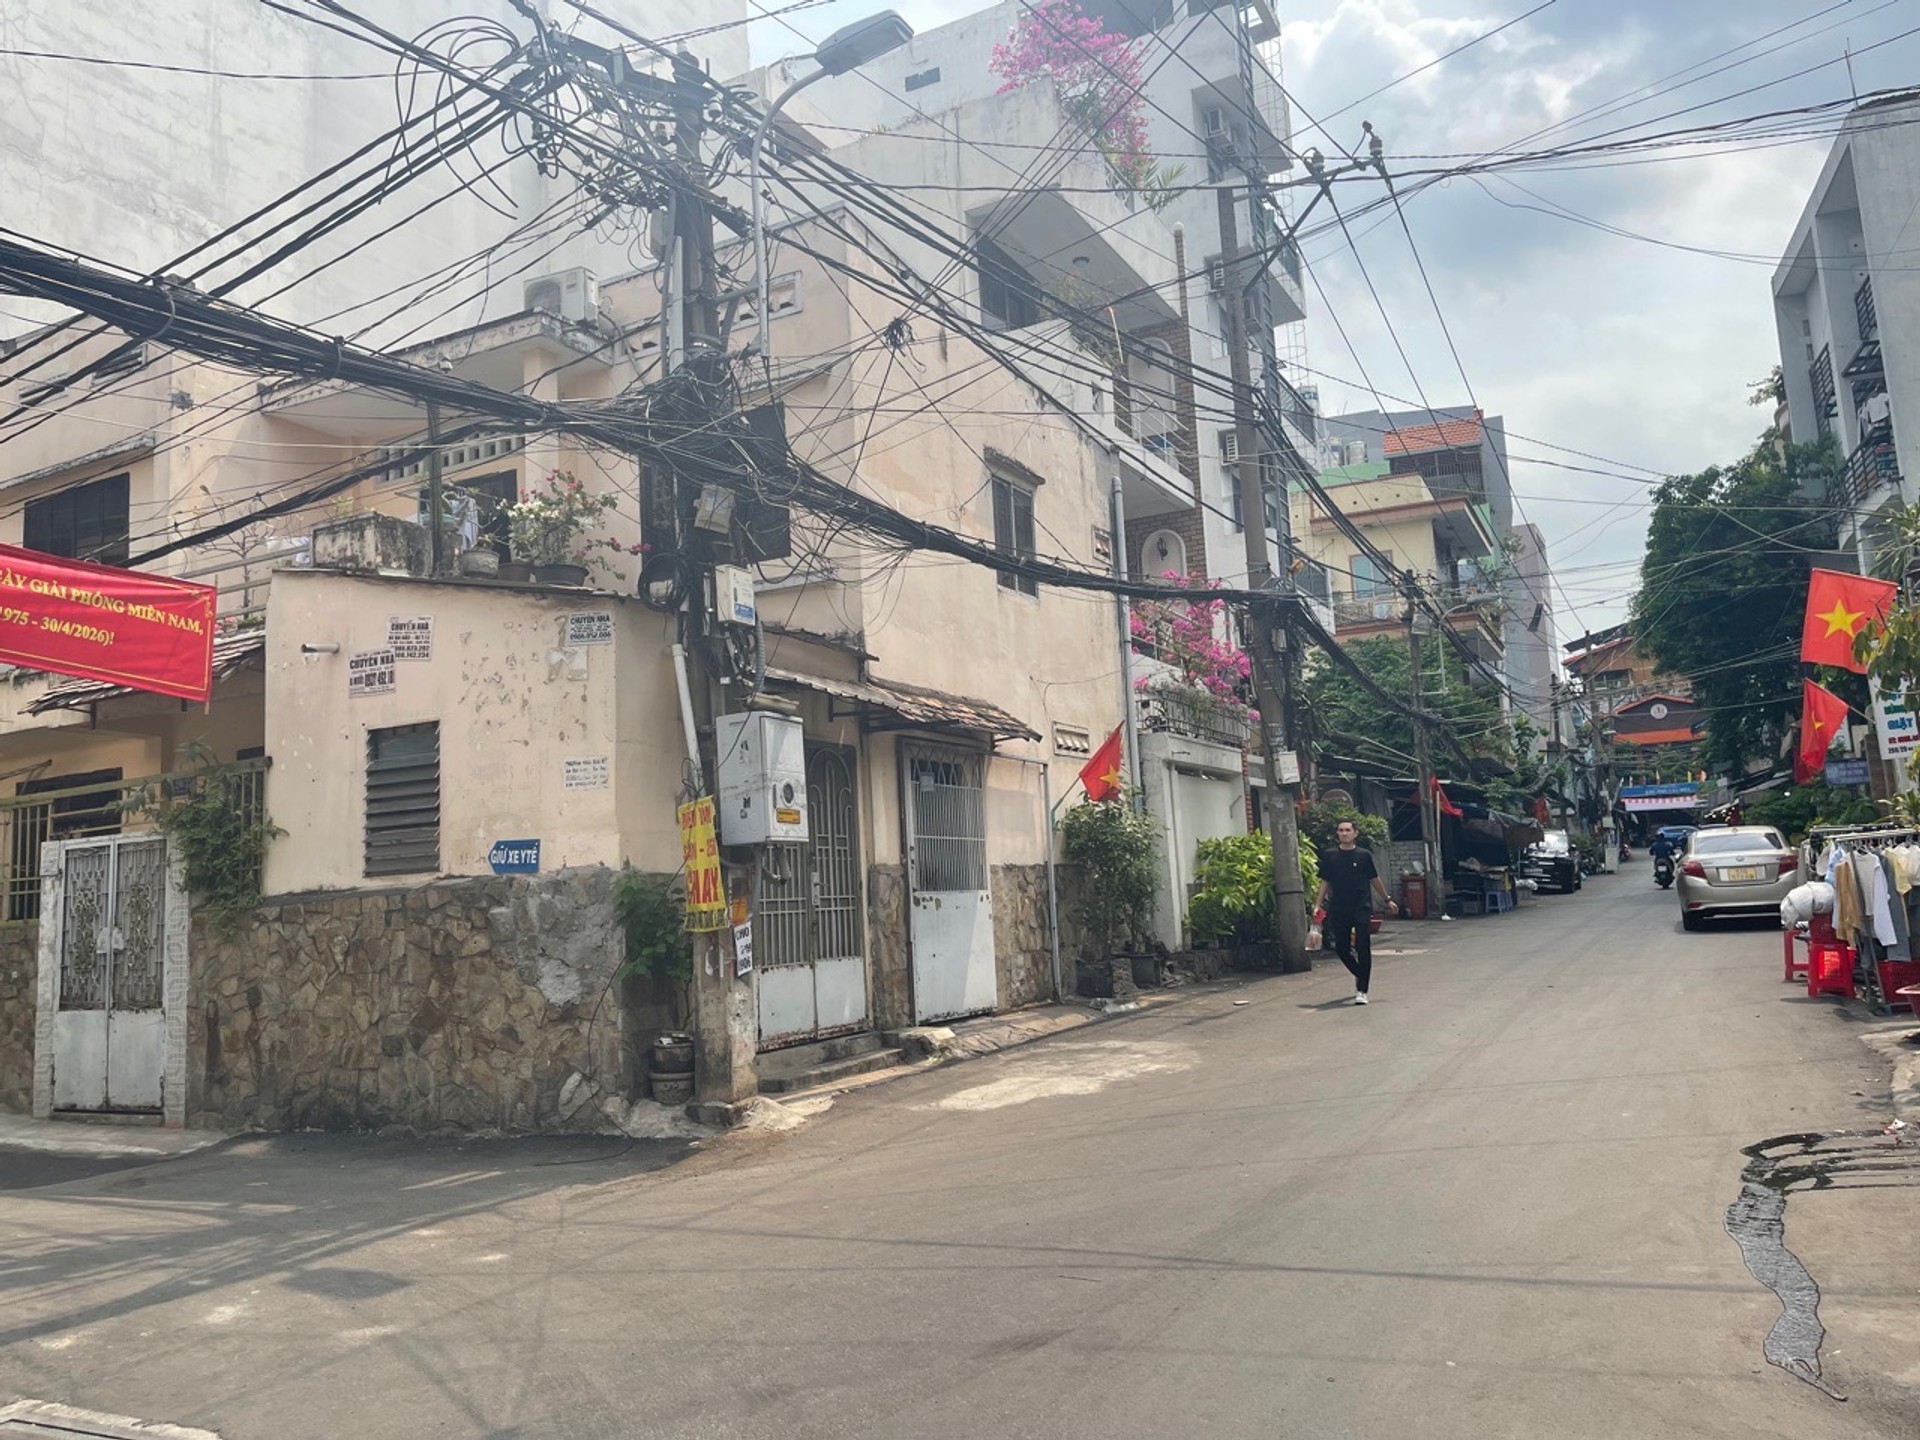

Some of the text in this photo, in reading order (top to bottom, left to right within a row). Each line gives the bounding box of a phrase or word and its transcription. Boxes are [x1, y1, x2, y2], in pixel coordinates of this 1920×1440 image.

[40, 616, 115, 646] 30/4/2026)!
[70, 588, 125, 614] PHÓNG
[127, 603, 166, 624] MIỀN
[168, 613, 204, 636] NAM,
